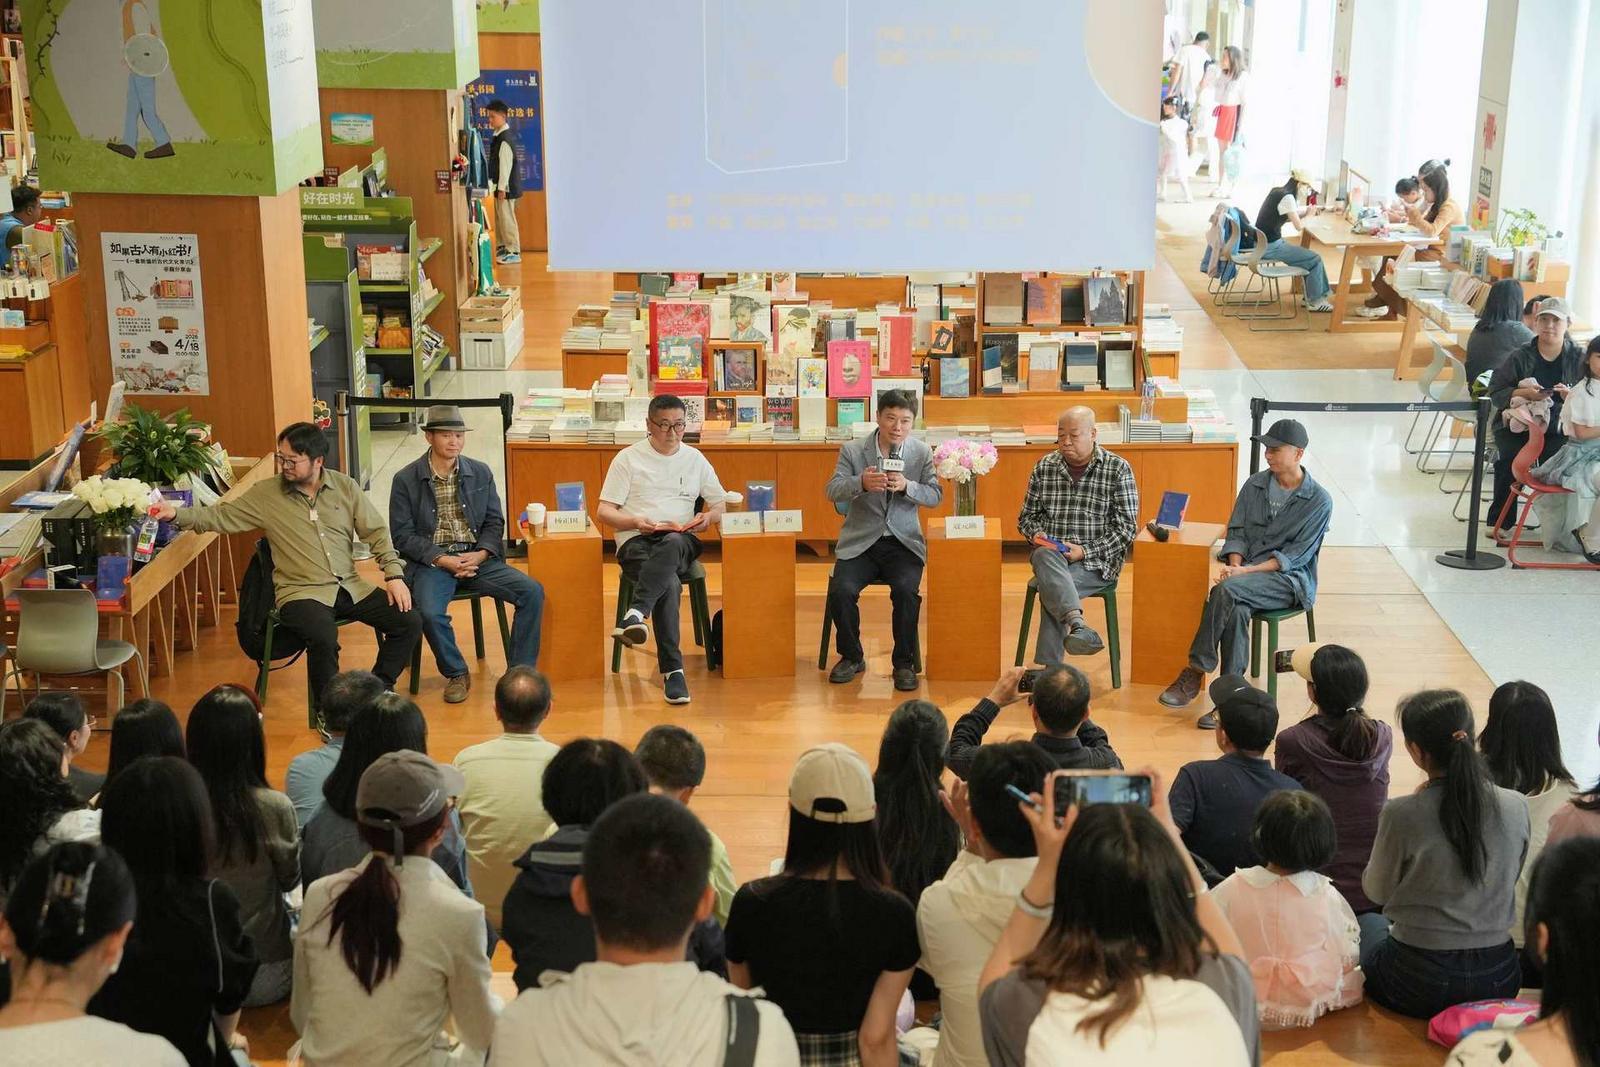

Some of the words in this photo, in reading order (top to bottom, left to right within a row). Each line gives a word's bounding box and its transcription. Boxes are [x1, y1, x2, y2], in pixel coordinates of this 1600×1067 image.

[303, 192, 355, 205] 好在时光
[174, 339, 200, 351] 4/18
